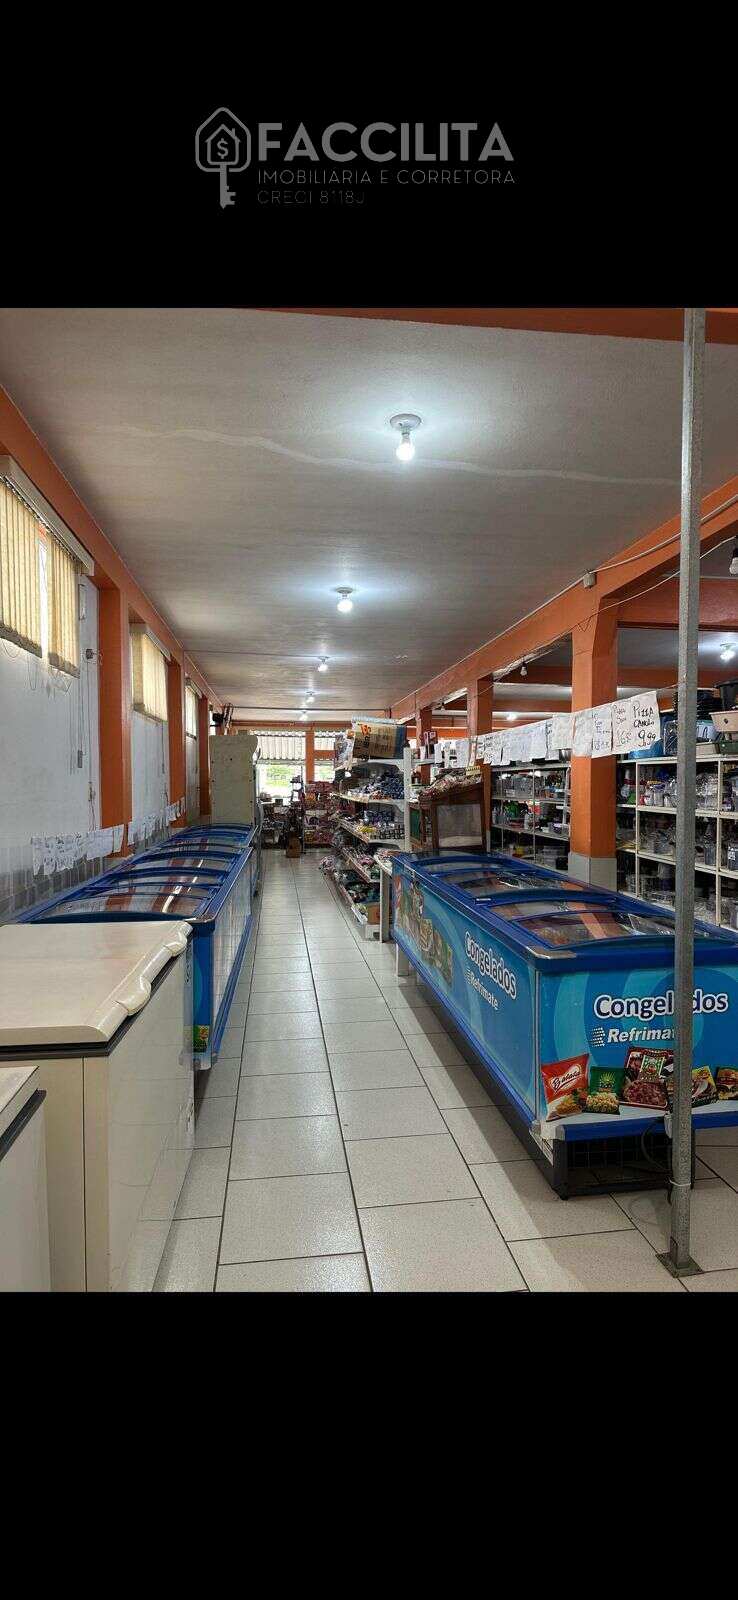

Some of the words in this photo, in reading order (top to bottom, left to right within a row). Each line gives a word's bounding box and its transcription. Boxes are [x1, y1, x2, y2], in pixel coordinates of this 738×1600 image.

[465, 931, 516, 999] Congelados
[469, 971, 499, 1011] Refrimate
[594, 989, 728, 1021] Congeldos
